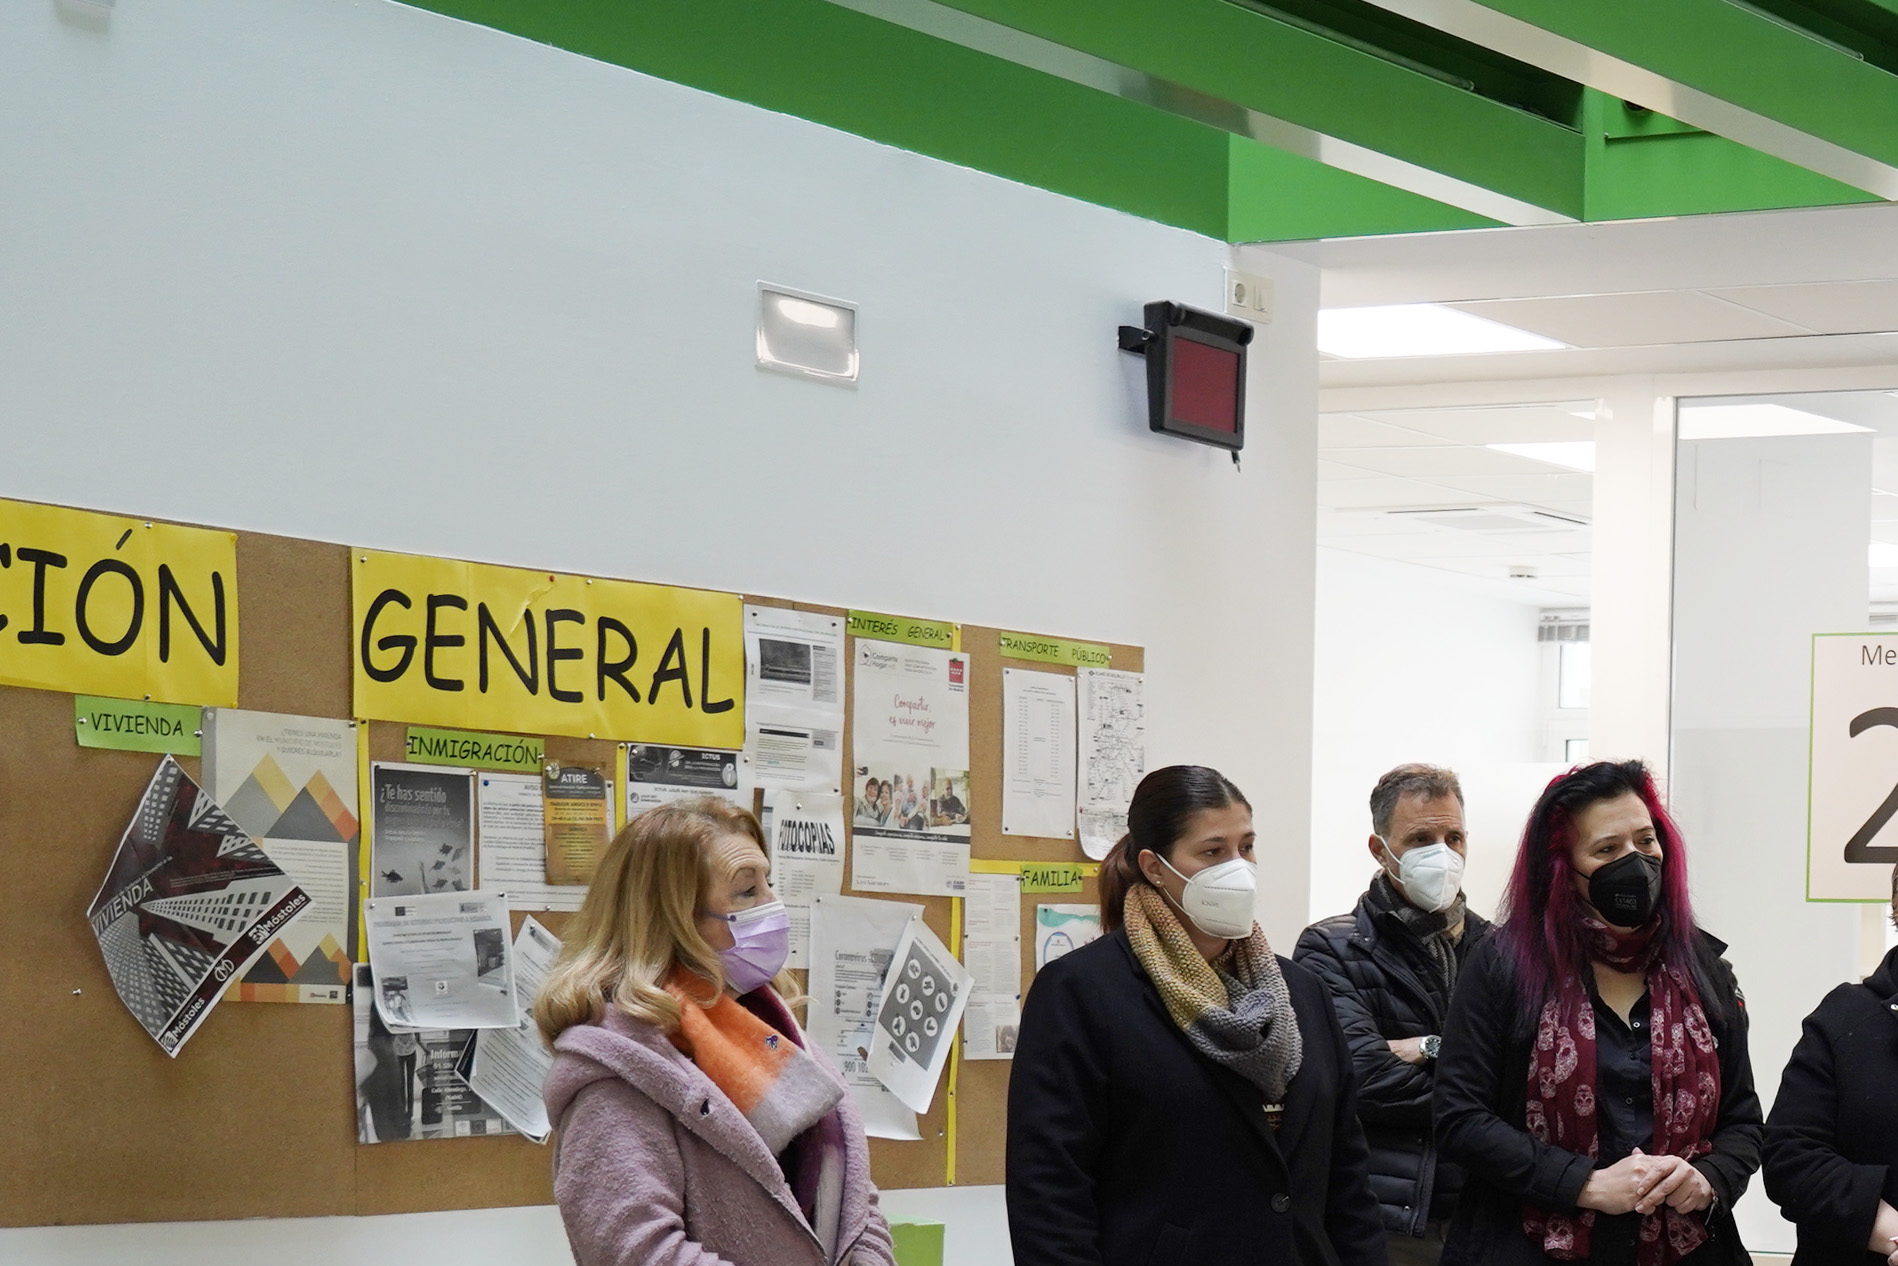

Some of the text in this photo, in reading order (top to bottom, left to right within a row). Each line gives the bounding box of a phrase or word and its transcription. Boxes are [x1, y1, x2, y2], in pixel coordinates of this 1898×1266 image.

[0, 528, 226, 667] IÓN
[360, 588, 735, 714] GENERAL
[851, 617, 899, 636] INTERÉS
[907, 626, 945, 641] GENERAL
[1001, 637, 1106, 665] TRANSPORTE PÚBLICO
[91, 712, 184, 737] VIVIENDA
[408, 736, 538, 765] INMIGRACIÓN
[701, 752, 721, 761] ICTUS
[561, 773, 588, 783] ATIRE
[380, 783, 447, 803] ¿Te has sentido
[777, 819, 835, 855] FOTOCOPIAS
[1023, 869, 1078, 887] FAMILIA
[91, 877, 154, 937] VIVIENDA
[264, 893, 306, 933] Móstoles
[172, 996, 206, 1039] Móstoles
